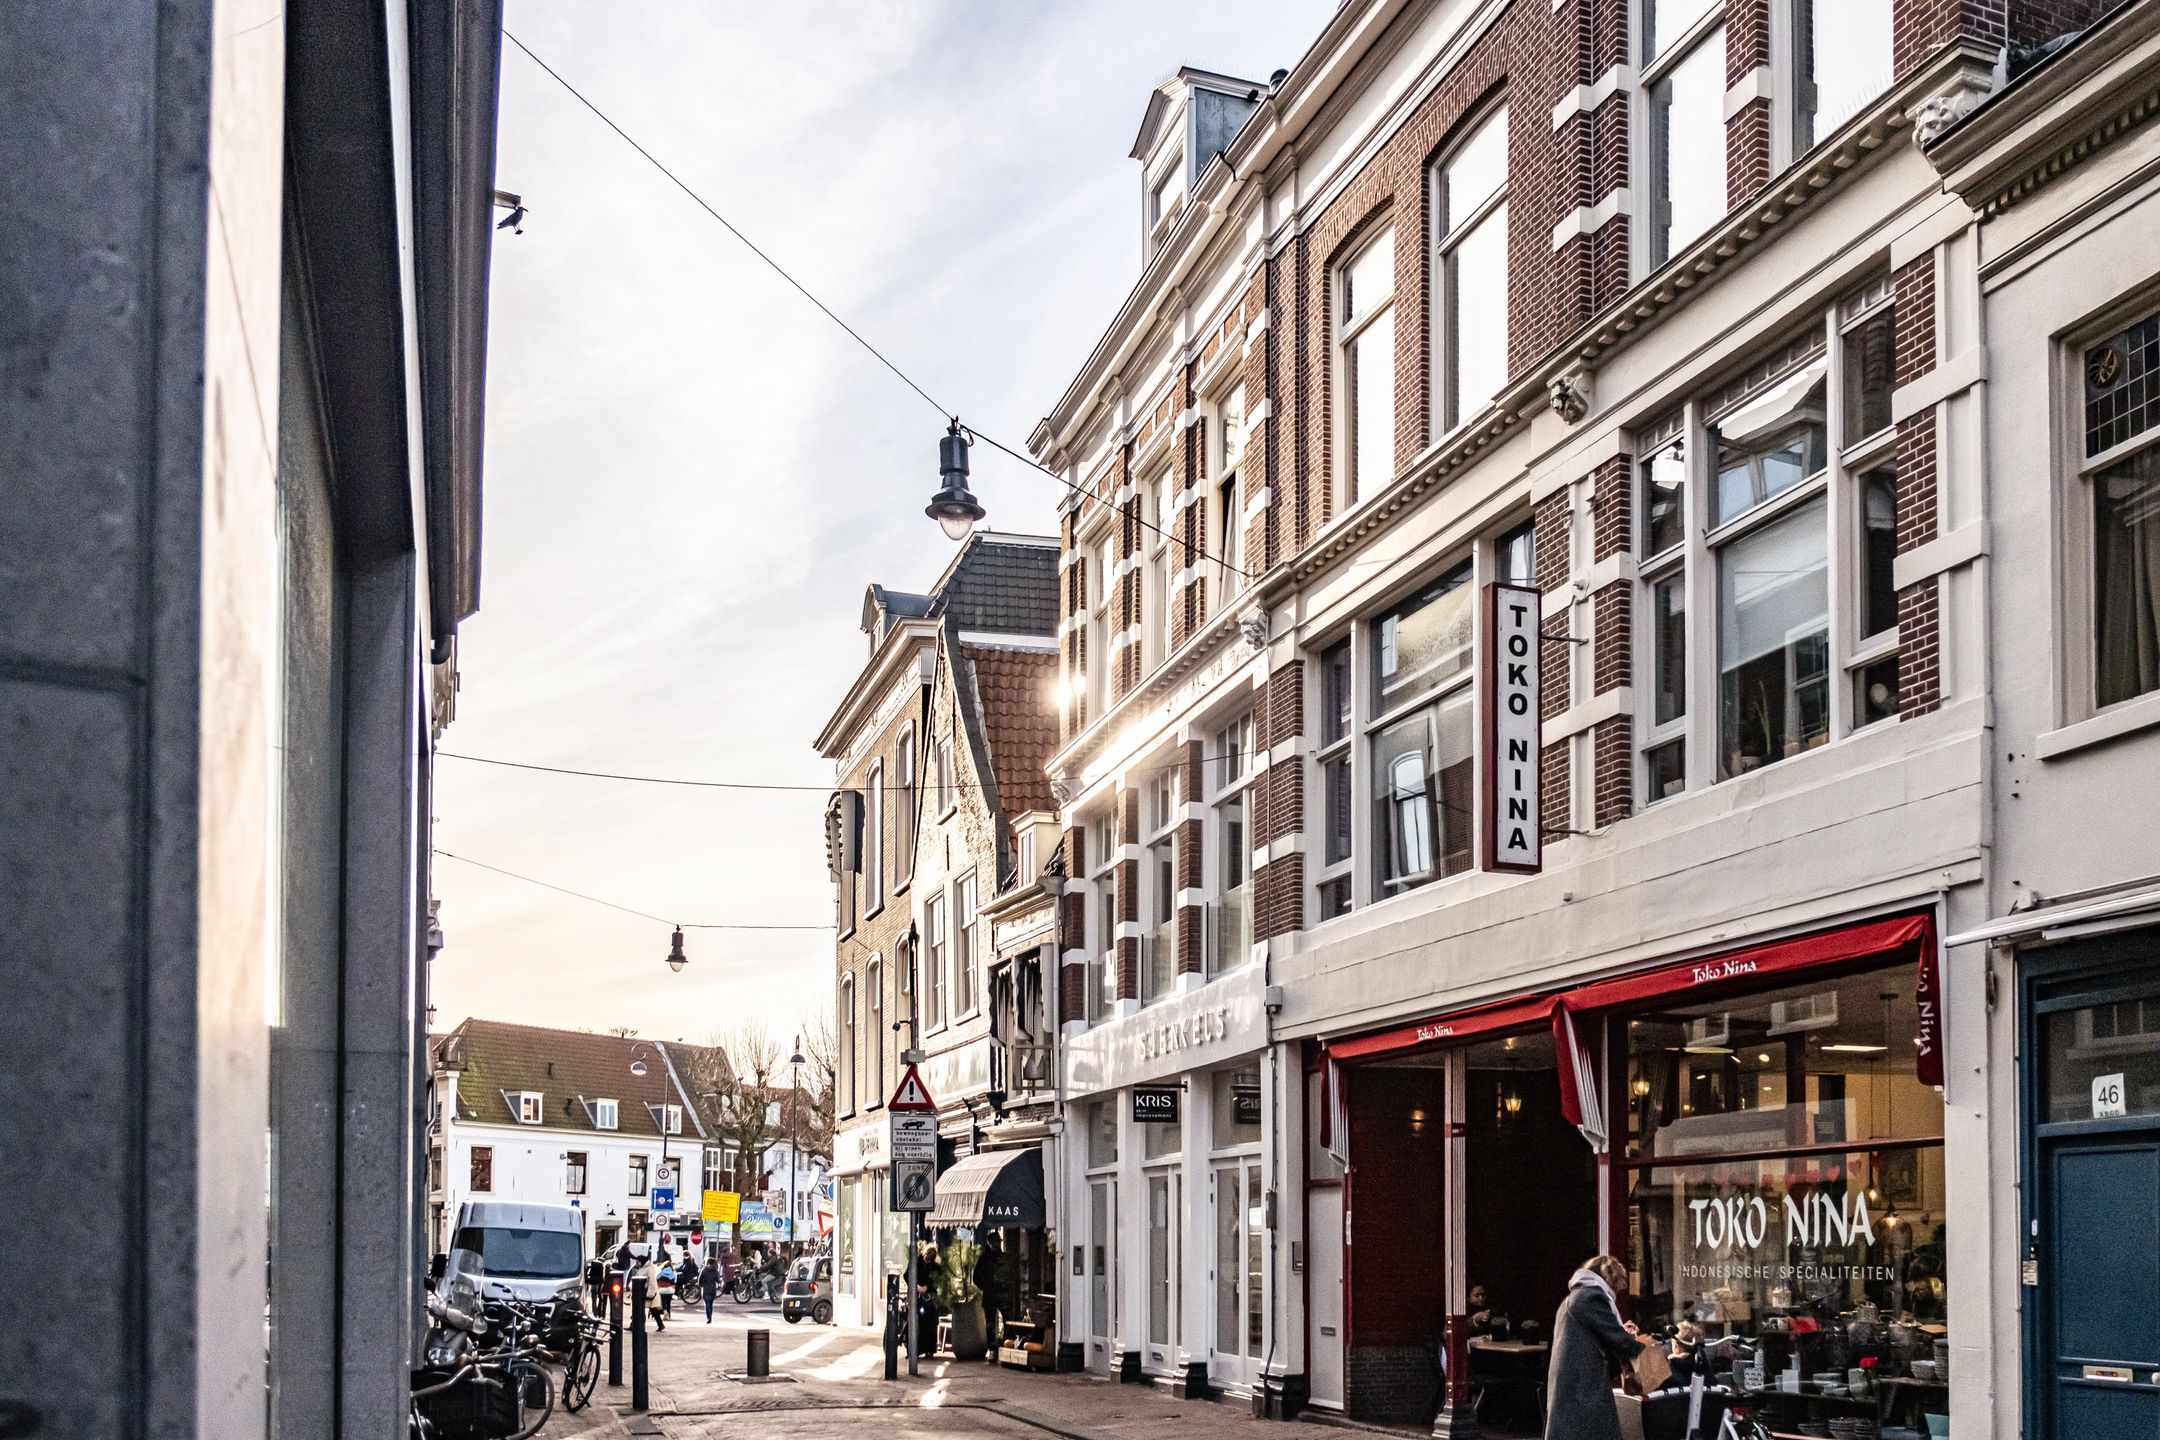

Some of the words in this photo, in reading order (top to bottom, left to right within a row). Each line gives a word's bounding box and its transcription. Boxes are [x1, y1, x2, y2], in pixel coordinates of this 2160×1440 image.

[1508, 604, 1528, 715] TOKO
[1508, 739, 1528, 850] NINA
[1692, 964, 1720, 982] Toko
[1723, 960, 1756, 976] Nina
[1417, 1027, 1433, 1040] Toko
[1434, 1025, 1453, 1037] Nina
[2098, 1085, 2119, 1105] 46
[988, 1206, 1019, 1216] KAAS
[1689, 1197, 1766, 1249] TOKO
[1783, 1191, 1875, 1247] NINA
[1679, 1265, 1769, 1279] INDONESISCHE
[1779, 1265, 1894, 1281] SPECIALITEITEN
